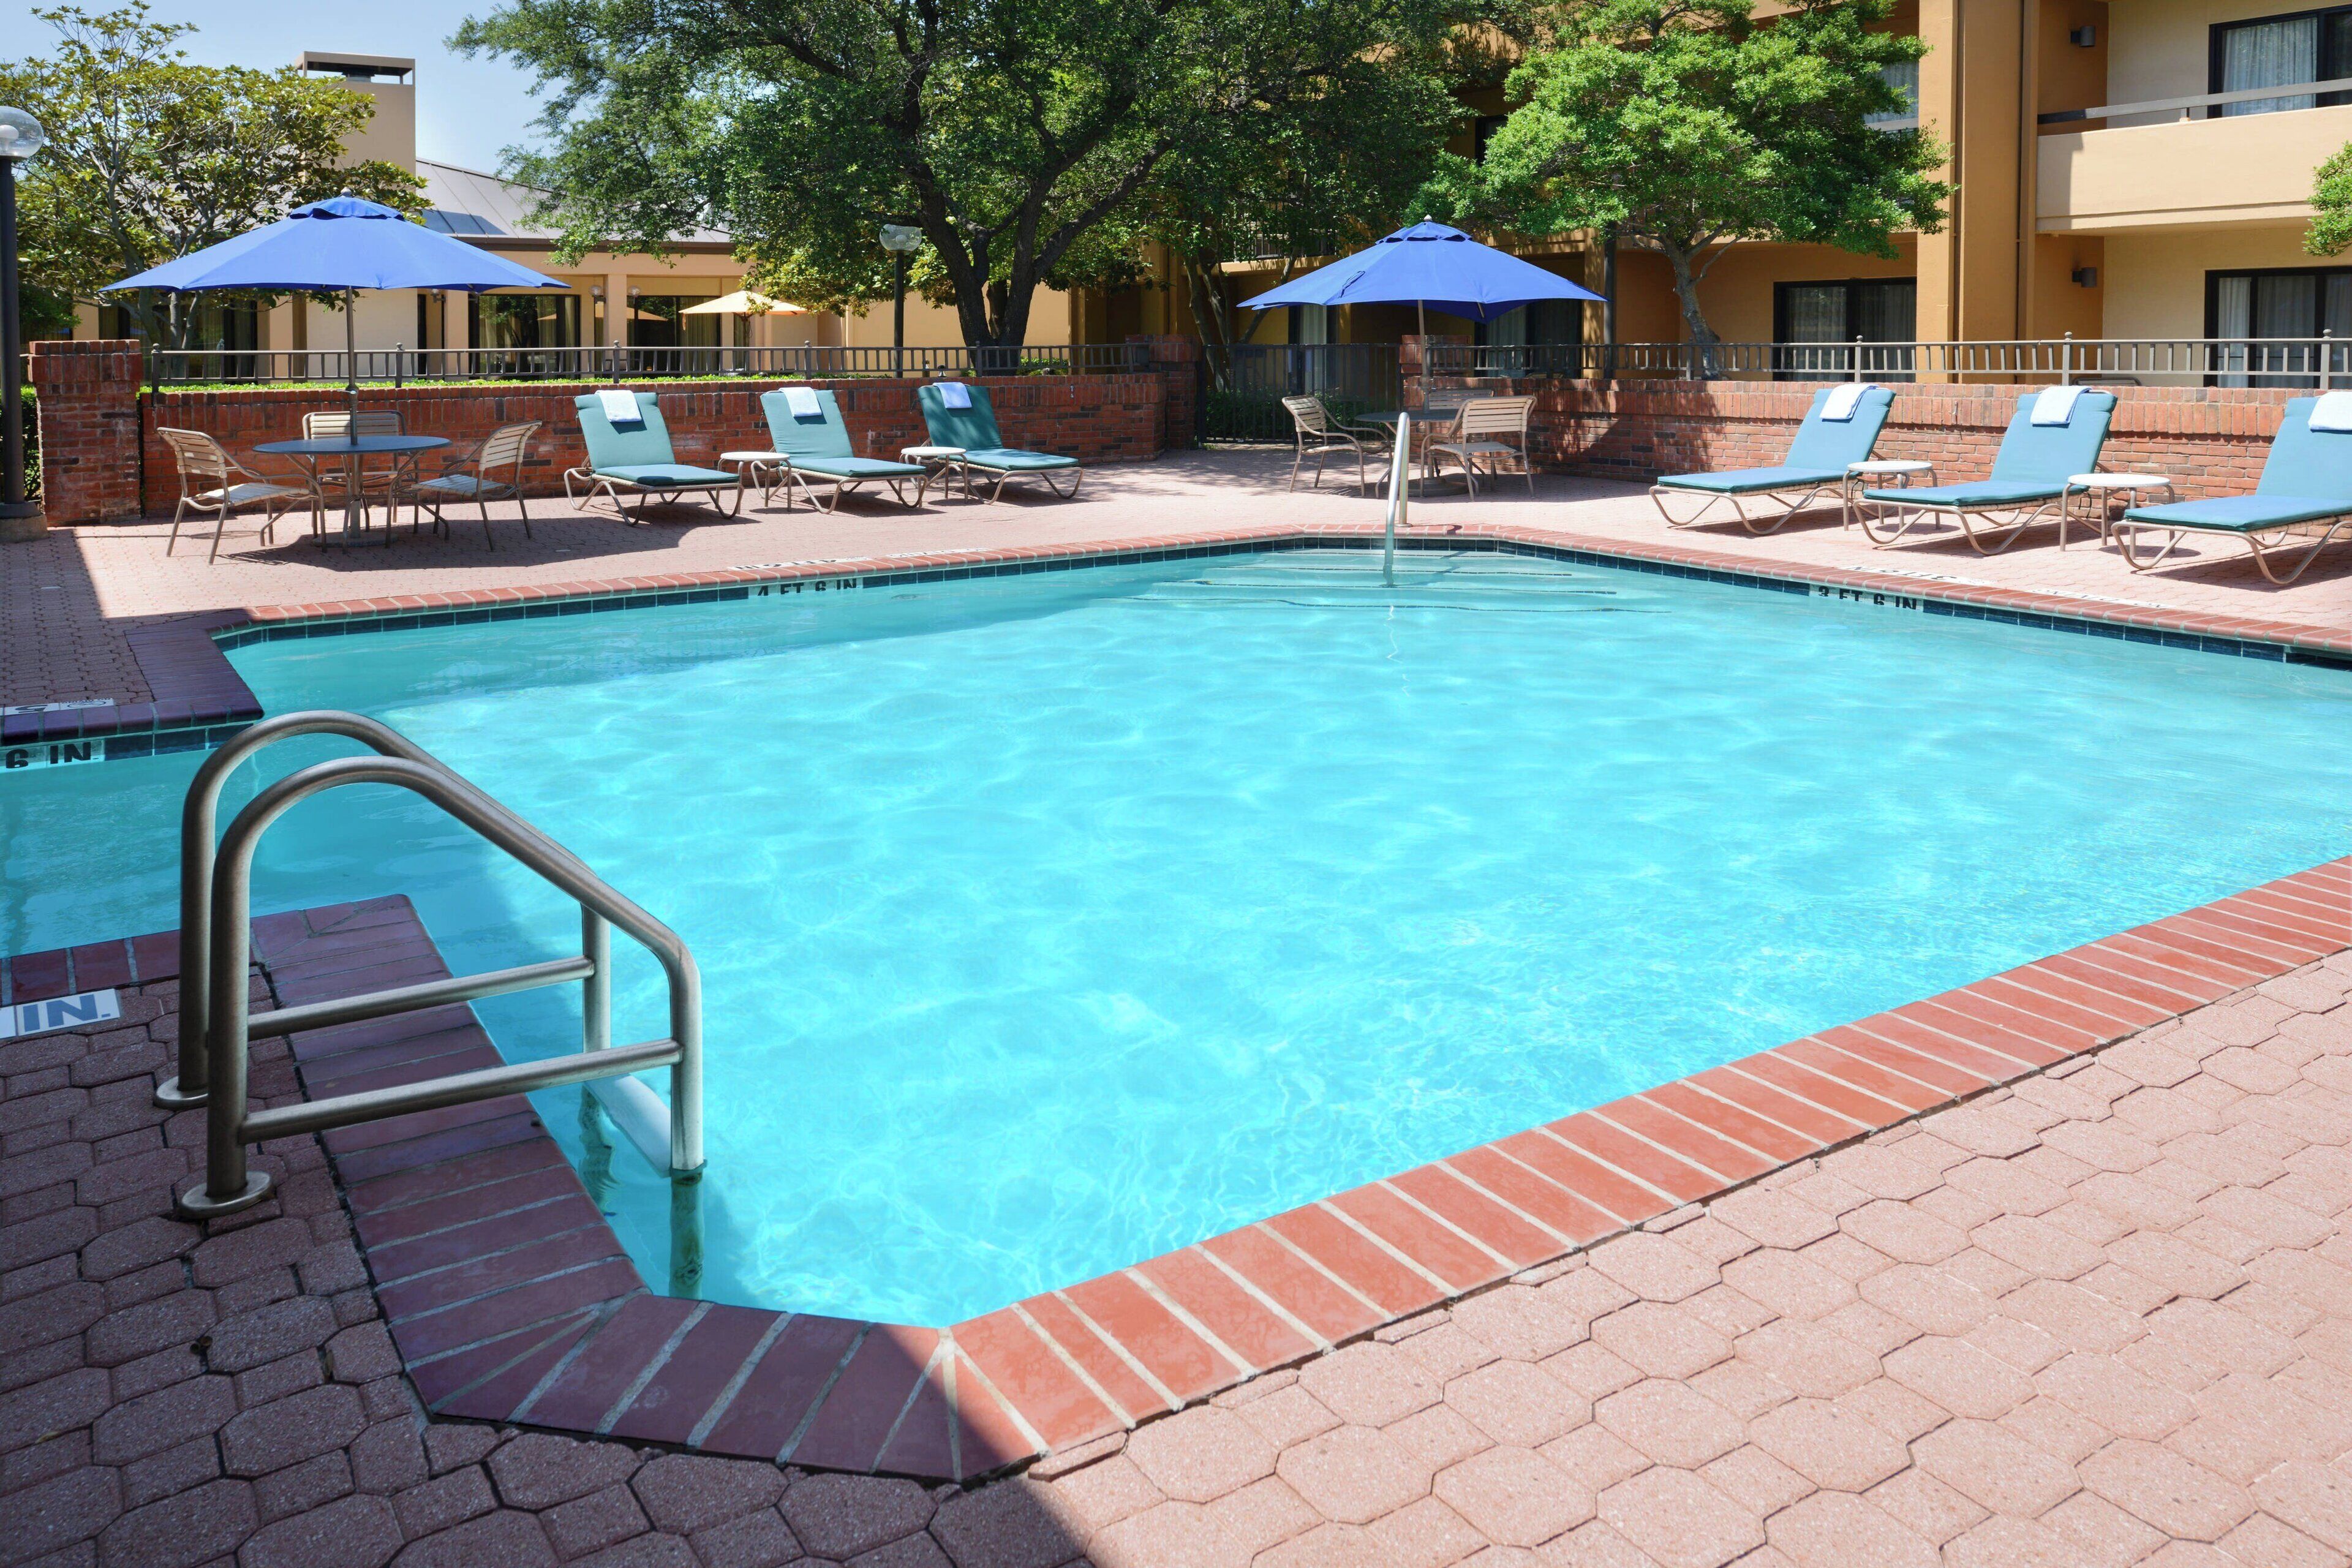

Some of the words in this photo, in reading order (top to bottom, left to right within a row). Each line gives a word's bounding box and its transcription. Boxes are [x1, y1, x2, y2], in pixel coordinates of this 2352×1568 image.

[758, 586, 769, 596] 4
[780, 582, 804, 595] FT
[815, 581, 826, 592] 6
[1819, 586, 1830, 597] 3
[1839, 589, 1863, 601] FT
[1874, 594, 1885, 605] 6
[1896, 596, 1917, 610] IN
[15, 704, 48, 714] 5
[6, 748, 29, 769] 6
